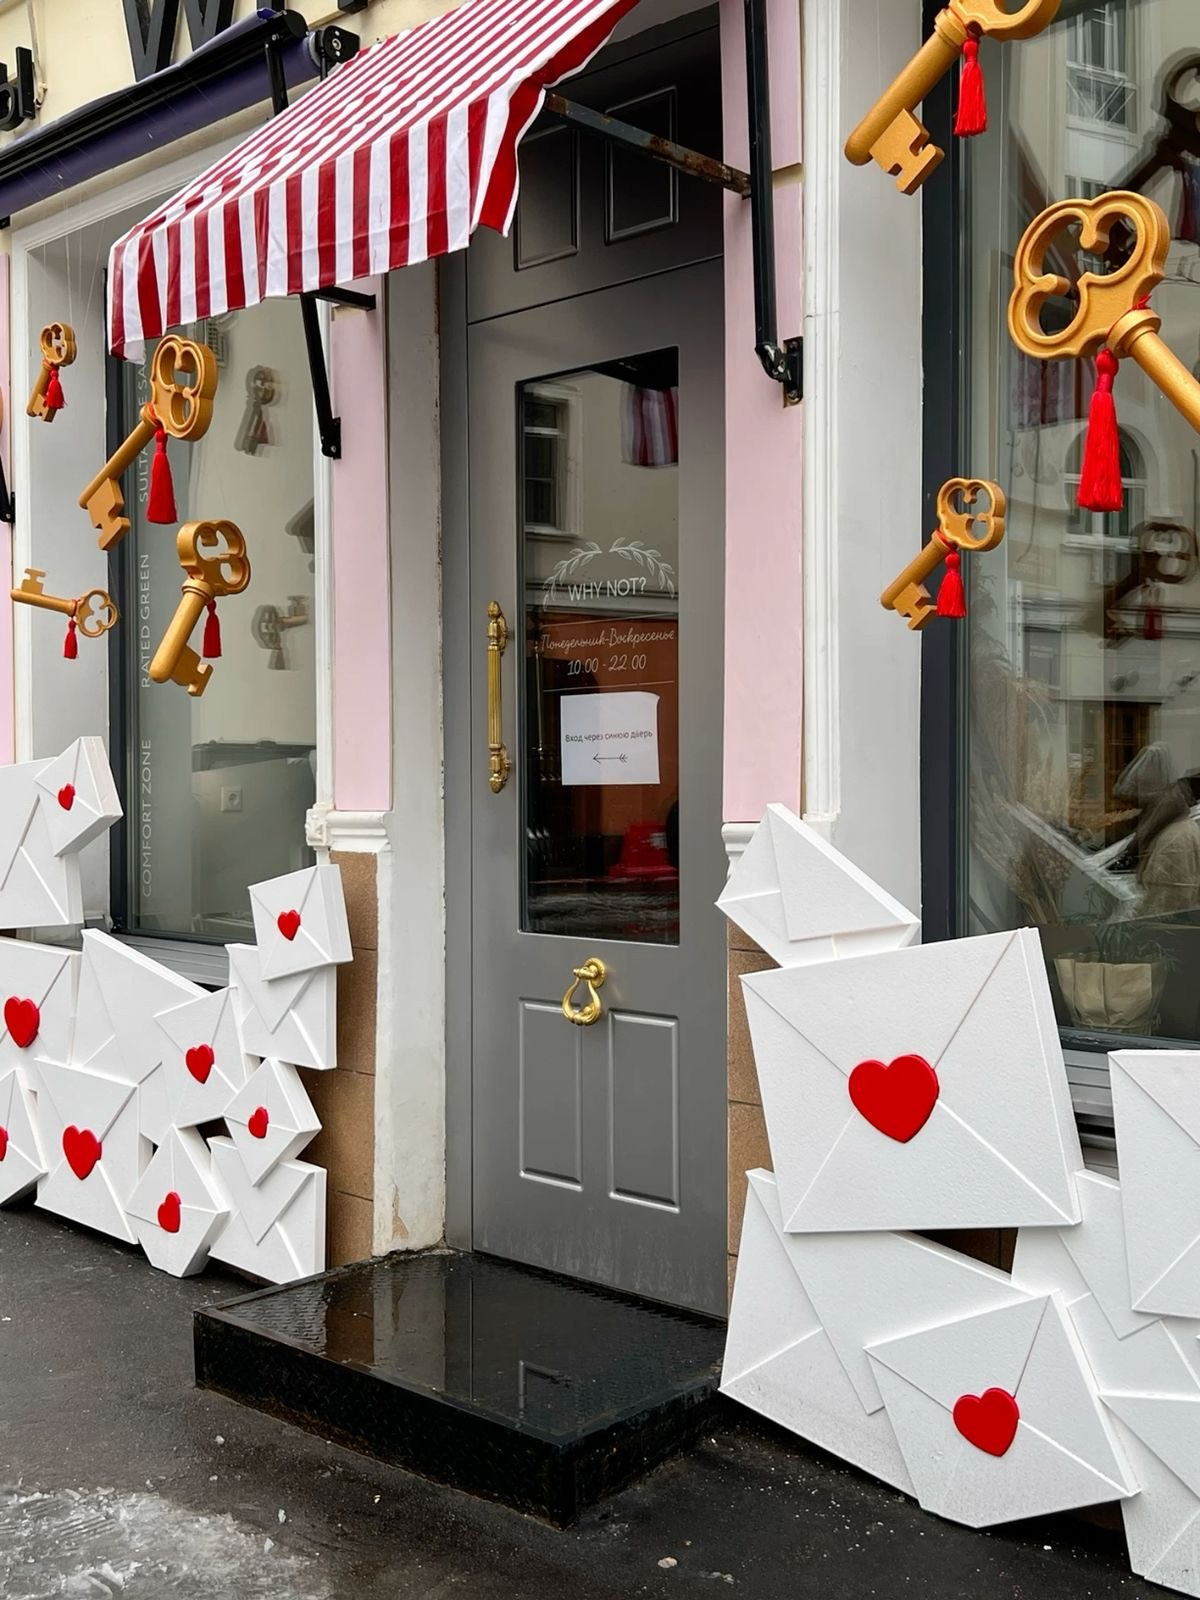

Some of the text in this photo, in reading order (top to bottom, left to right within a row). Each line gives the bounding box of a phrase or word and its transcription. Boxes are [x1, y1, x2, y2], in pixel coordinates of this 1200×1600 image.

[140, 555, 151, 687] RATED GREEN
[568, 576, 647, 601] WHY NOT?
[565, 734, 583, 743] Вход
[584, 734, 603, 742] через
[631, 730, 653, 739] дверь
[141, 739, 152, 897] COMFORT ZONE
